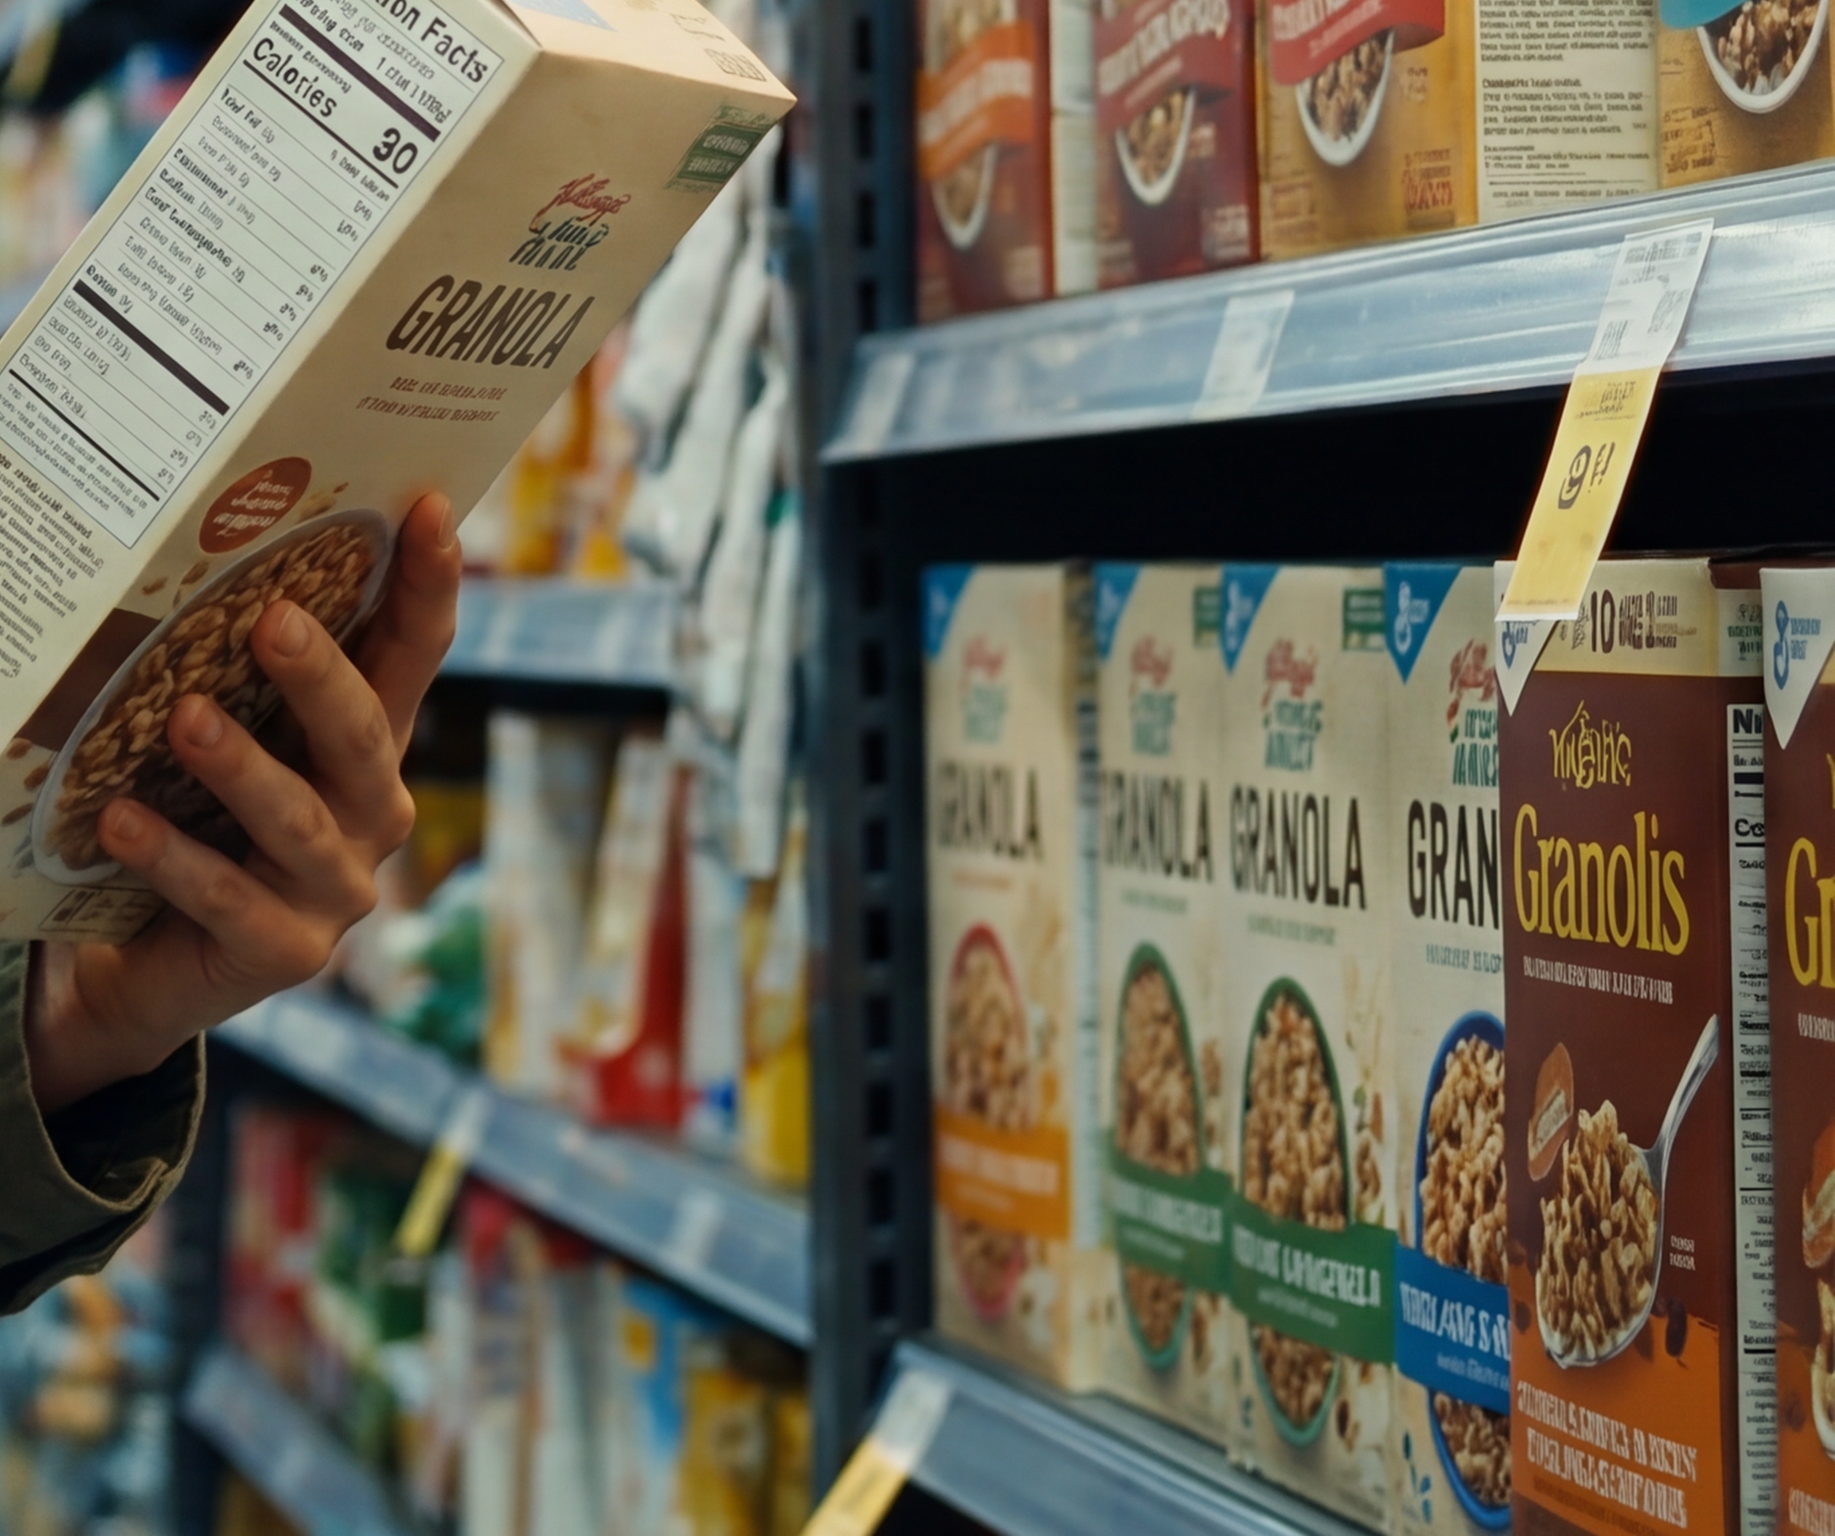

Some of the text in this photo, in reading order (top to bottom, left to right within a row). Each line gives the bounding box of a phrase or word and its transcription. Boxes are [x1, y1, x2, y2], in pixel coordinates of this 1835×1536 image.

[252, 37, 419, 175] Calories 30
[420, 17, 488, 83] Facts
[385, 274, 596, 370] GRANOLA
[1230, 781, 1367, 911] GRANOLA
[1407, 798, 1500, 931] GRAN
[1513, 803, 1690, 957] Granolis
